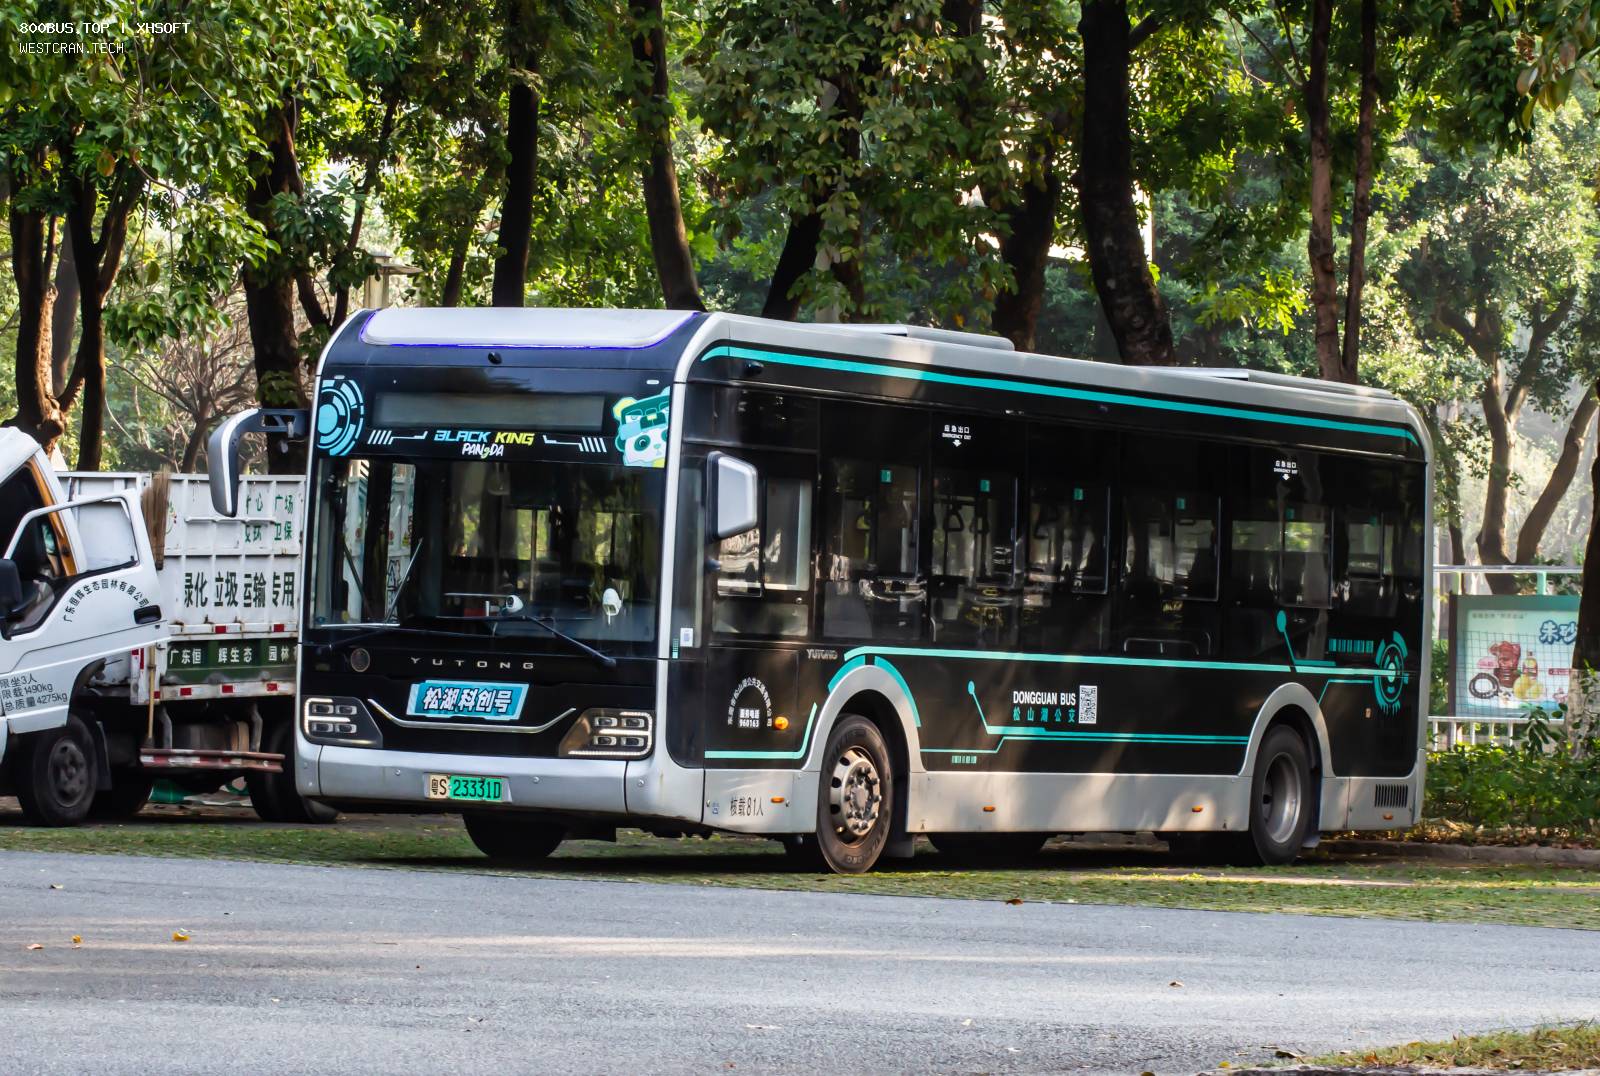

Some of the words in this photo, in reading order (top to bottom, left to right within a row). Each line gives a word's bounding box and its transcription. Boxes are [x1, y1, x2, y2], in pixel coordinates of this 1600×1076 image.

[434, 431, 491, 443] BLACK
[494, 432, 535, 446] KING
[63, 578, 150, 623] 广东恒辉生态园林有限公司
[411, 657, 534, 670] YUTONG
[423, 686, 512, 713] 松湖科创号
[1013, 691, 1057, 705] DONGGUAN
[1060, 692, 1076, 706] BUS
